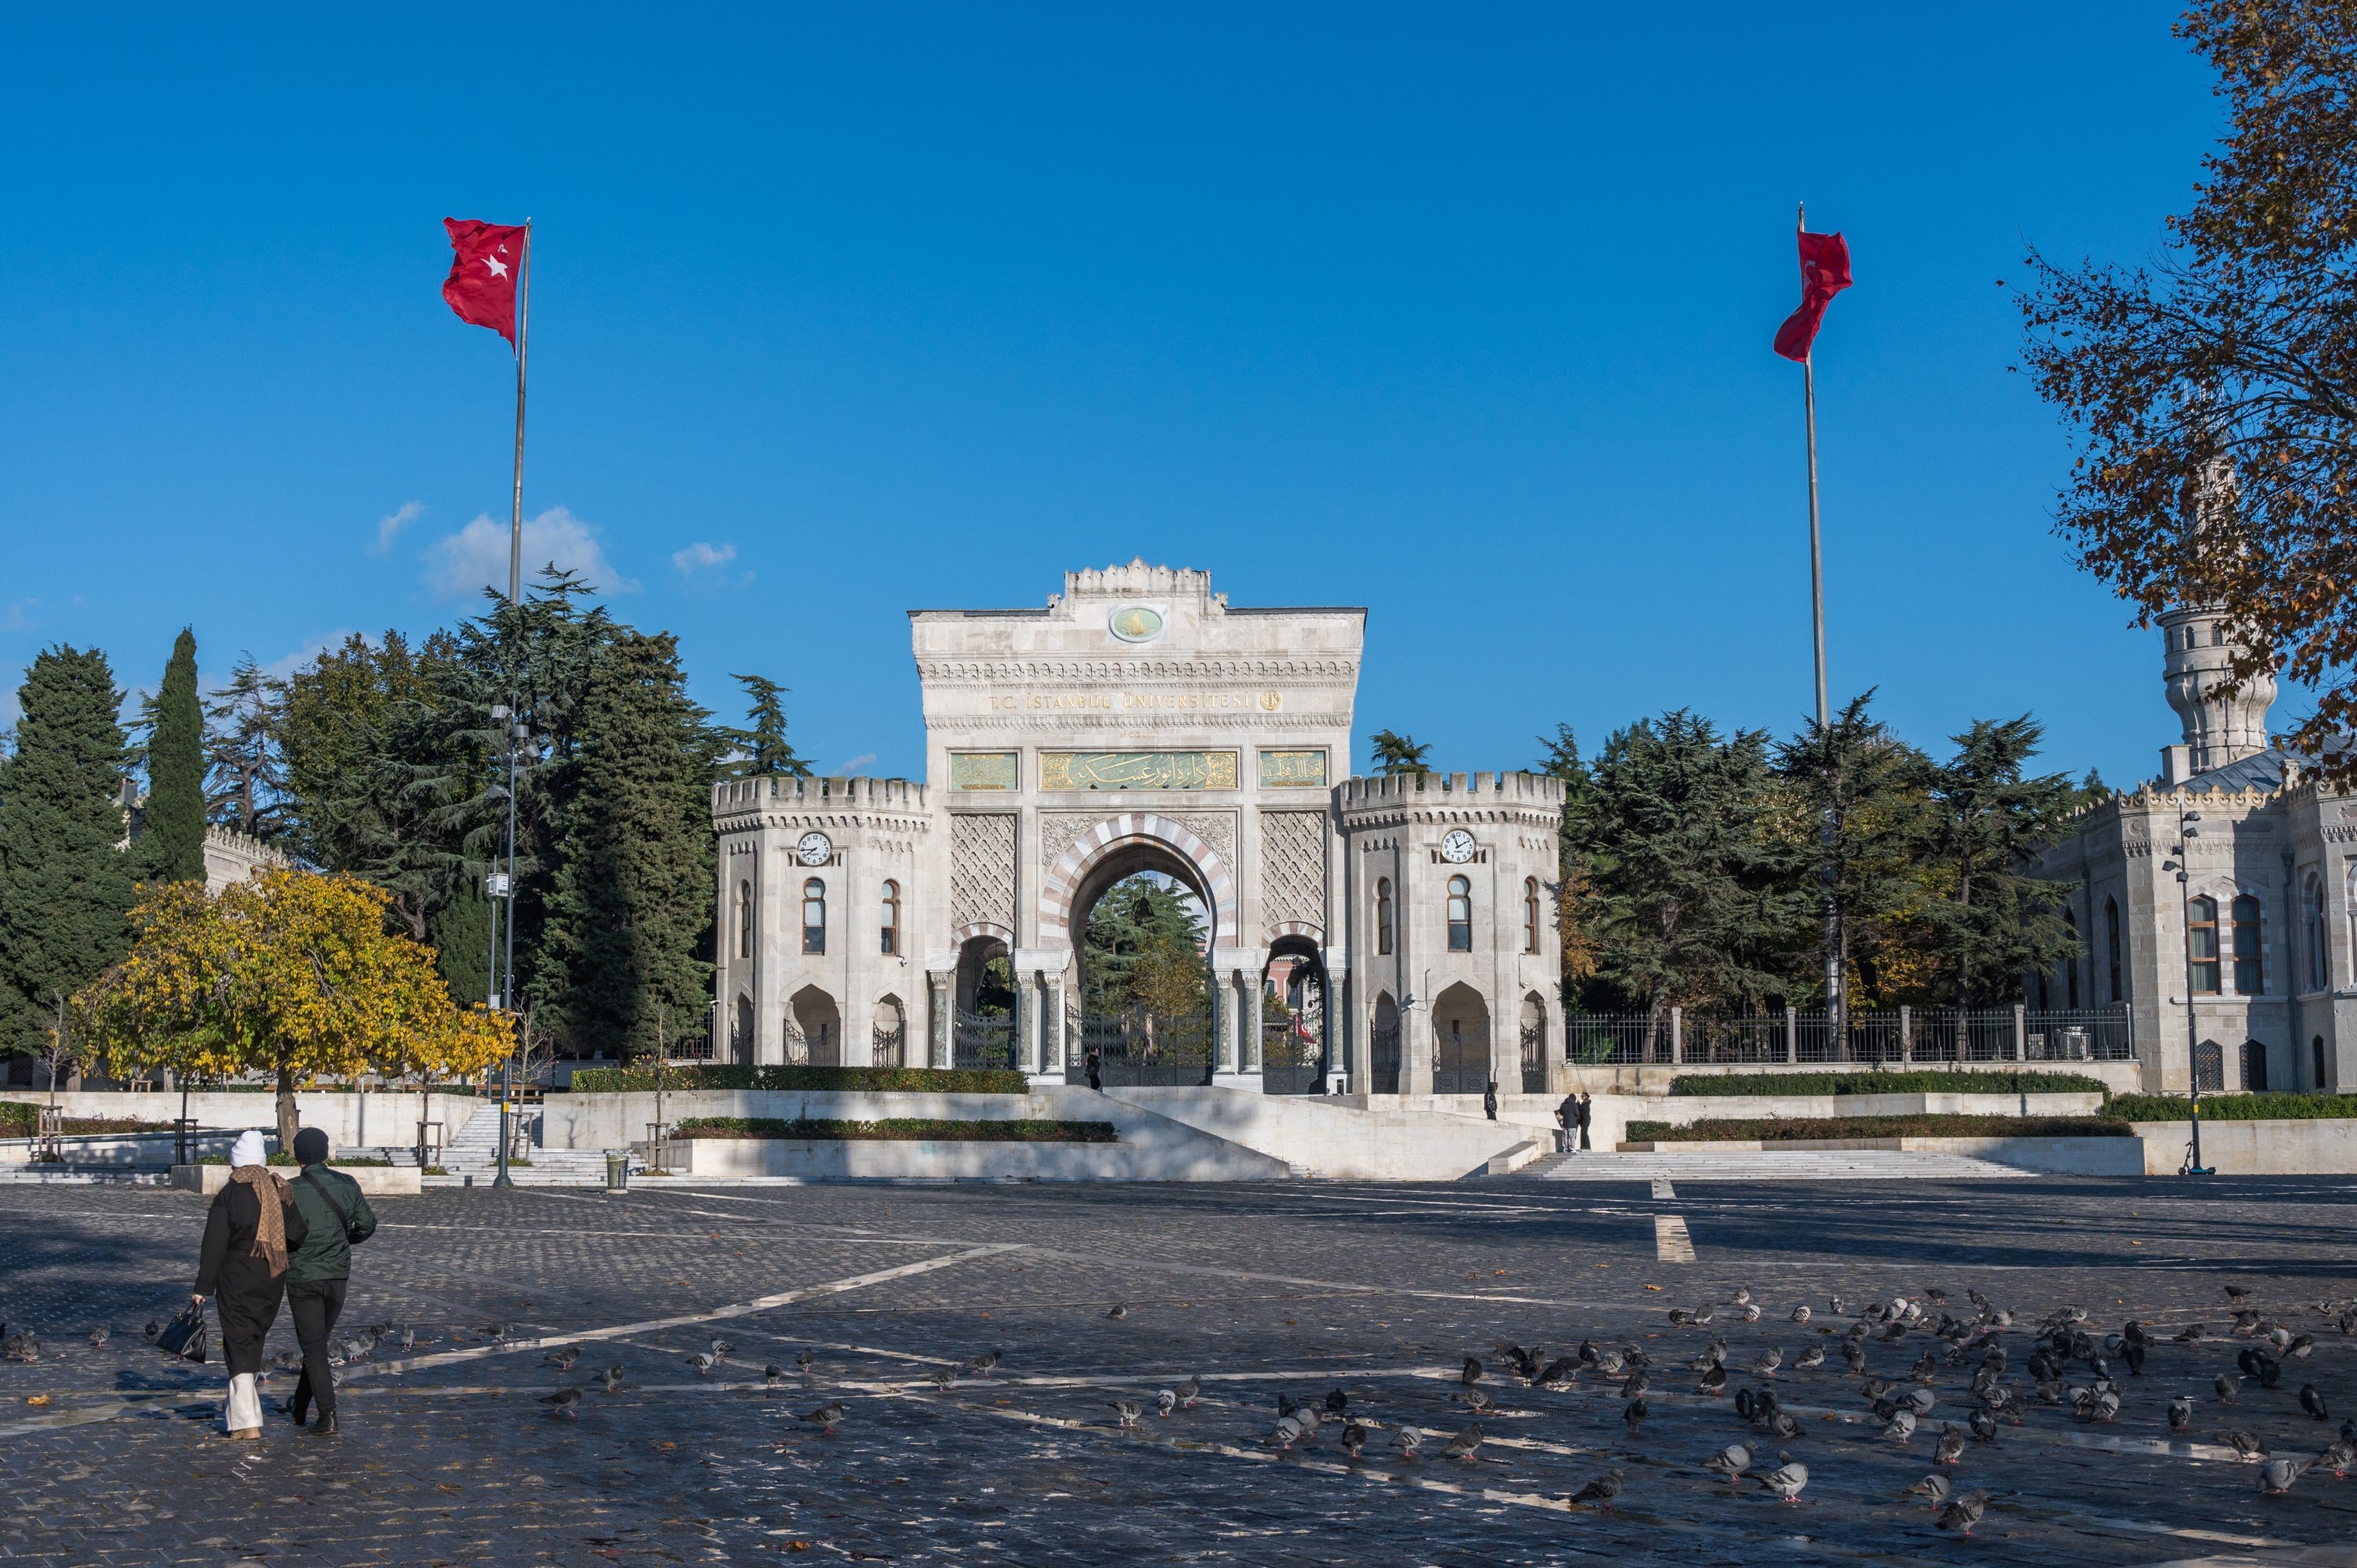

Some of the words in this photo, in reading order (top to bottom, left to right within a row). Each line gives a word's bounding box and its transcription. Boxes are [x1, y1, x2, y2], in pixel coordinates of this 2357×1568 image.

[988, 695, 1017, 709] T.C.
[1027, 692, 1110, 709] İSTANBUL
[1123, 691, 1249, 709] ÜNİVERSİTESİ
